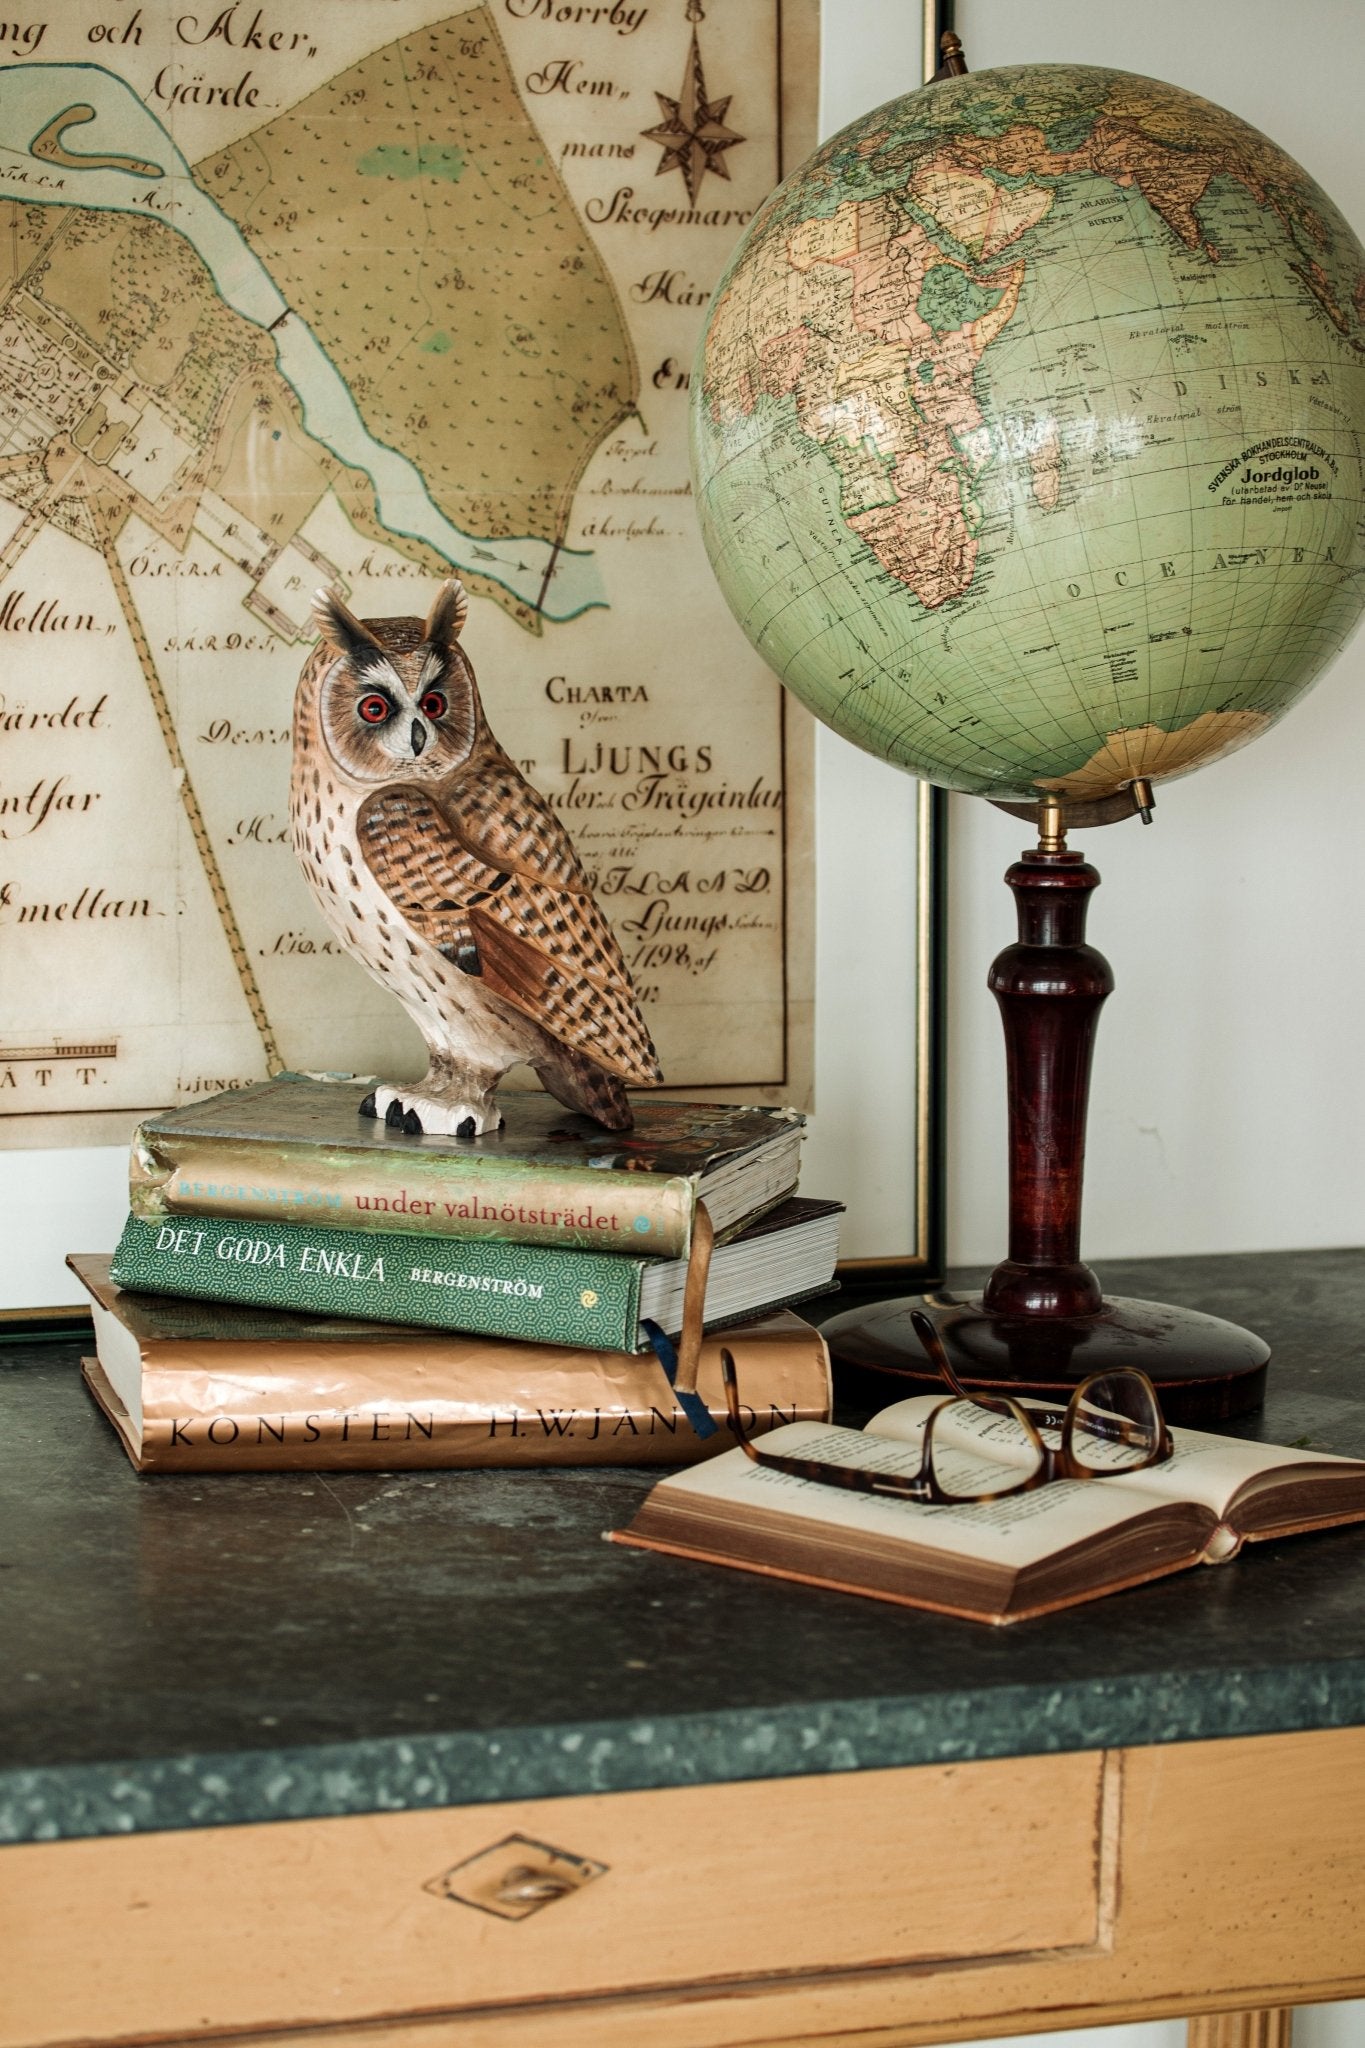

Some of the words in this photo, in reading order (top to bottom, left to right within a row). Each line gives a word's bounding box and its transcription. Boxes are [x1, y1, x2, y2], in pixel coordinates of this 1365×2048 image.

[88, 9, 143, 46] och
[1081, 368, 1332, 414] INDISKA
[1208, 458, 1242, 493] SVENSKA
[1241, 436, 1327, 463] BOKHANDELSCENTRALEN
[1240, 466, 1320, 485] Jordglob
[1258, 450, 1308, 465] STOCKHOLM
[1222, 496, 1237, 507] för
[1240, 494, 1274, 506] handel,
[1276, 494, 1293, 502] hem
[1296, 493, 1311, 502] och
[1313, 491, 1332, 500] skola
[1066, 546, 1337, 599] OCEANEN
[545, 676, 650, 704] CHARTA
[178, 1180, 343, 1210] BERGENSTRÖM
[355, 1190, 436, 1216] under
[443, 1196, 621, 1231] valnötsträdet
[155, 1226, 207, 1256] DET
[217, 1236, 285, 1268] GODA
[299, 1247, 385, 1282] ENKLA
[410, 1267, 544, 1299] BERGENSTRÖM
[170, 1411, 435, 1448] KONSTEN
[587, 1402, 798, 1441] JANON
